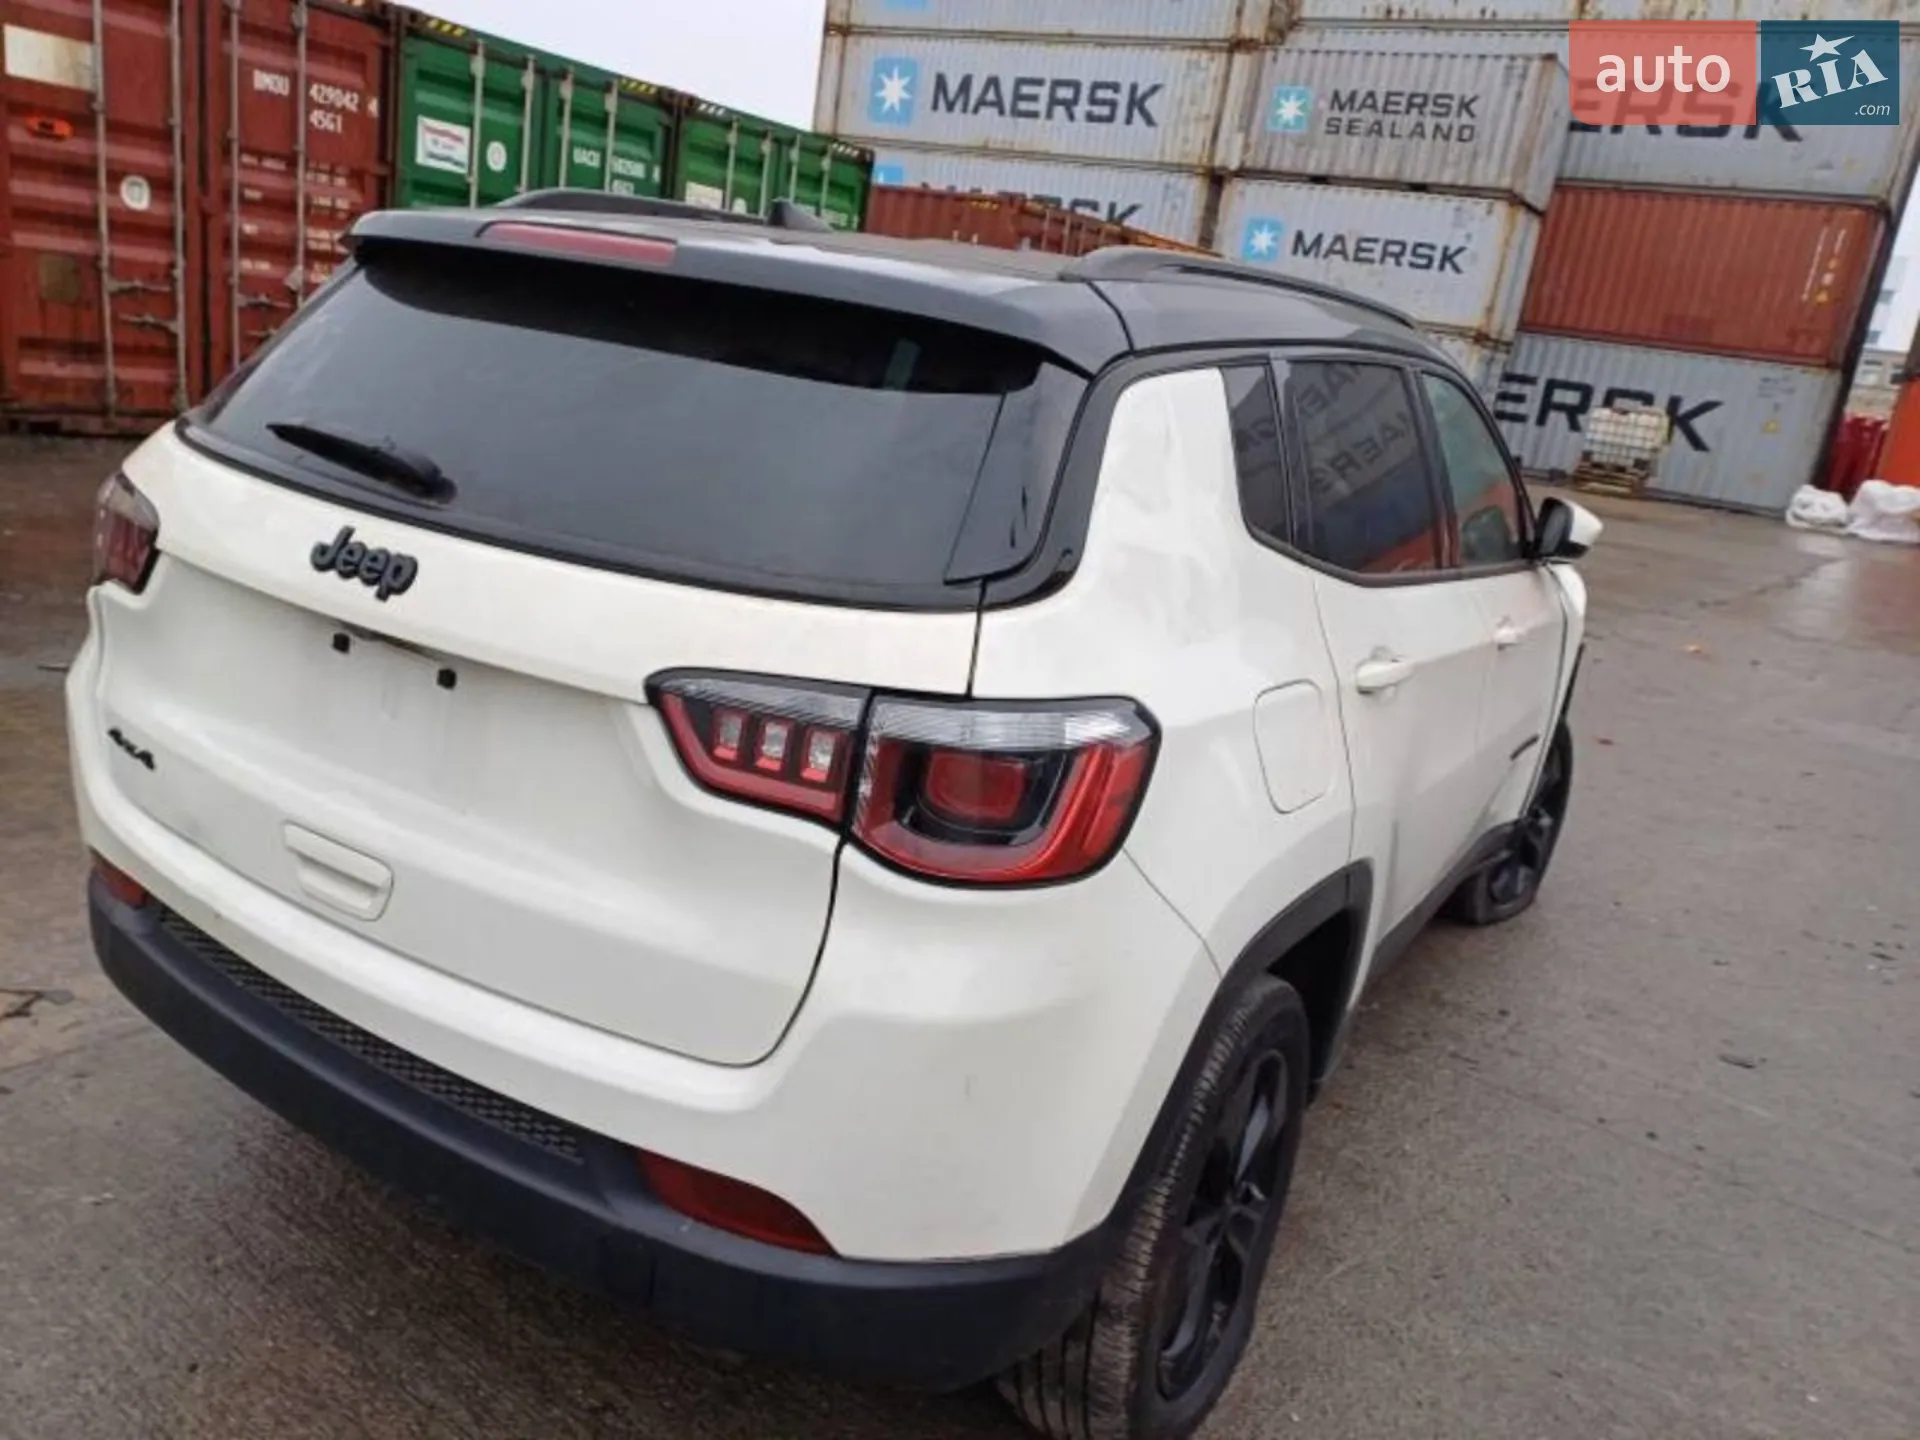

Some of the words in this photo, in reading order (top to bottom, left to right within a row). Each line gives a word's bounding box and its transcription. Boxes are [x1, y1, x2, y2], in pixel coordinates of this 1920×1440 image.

[930, 71, 1167, 128] MAERSK
[1329, 87, 1480, 120] MAERSK
[1323, 115, 1477, 143] SEALAND
[1290, 228, 1469, 276] MAERSK
[310, 525, 419, 603] Jeep
